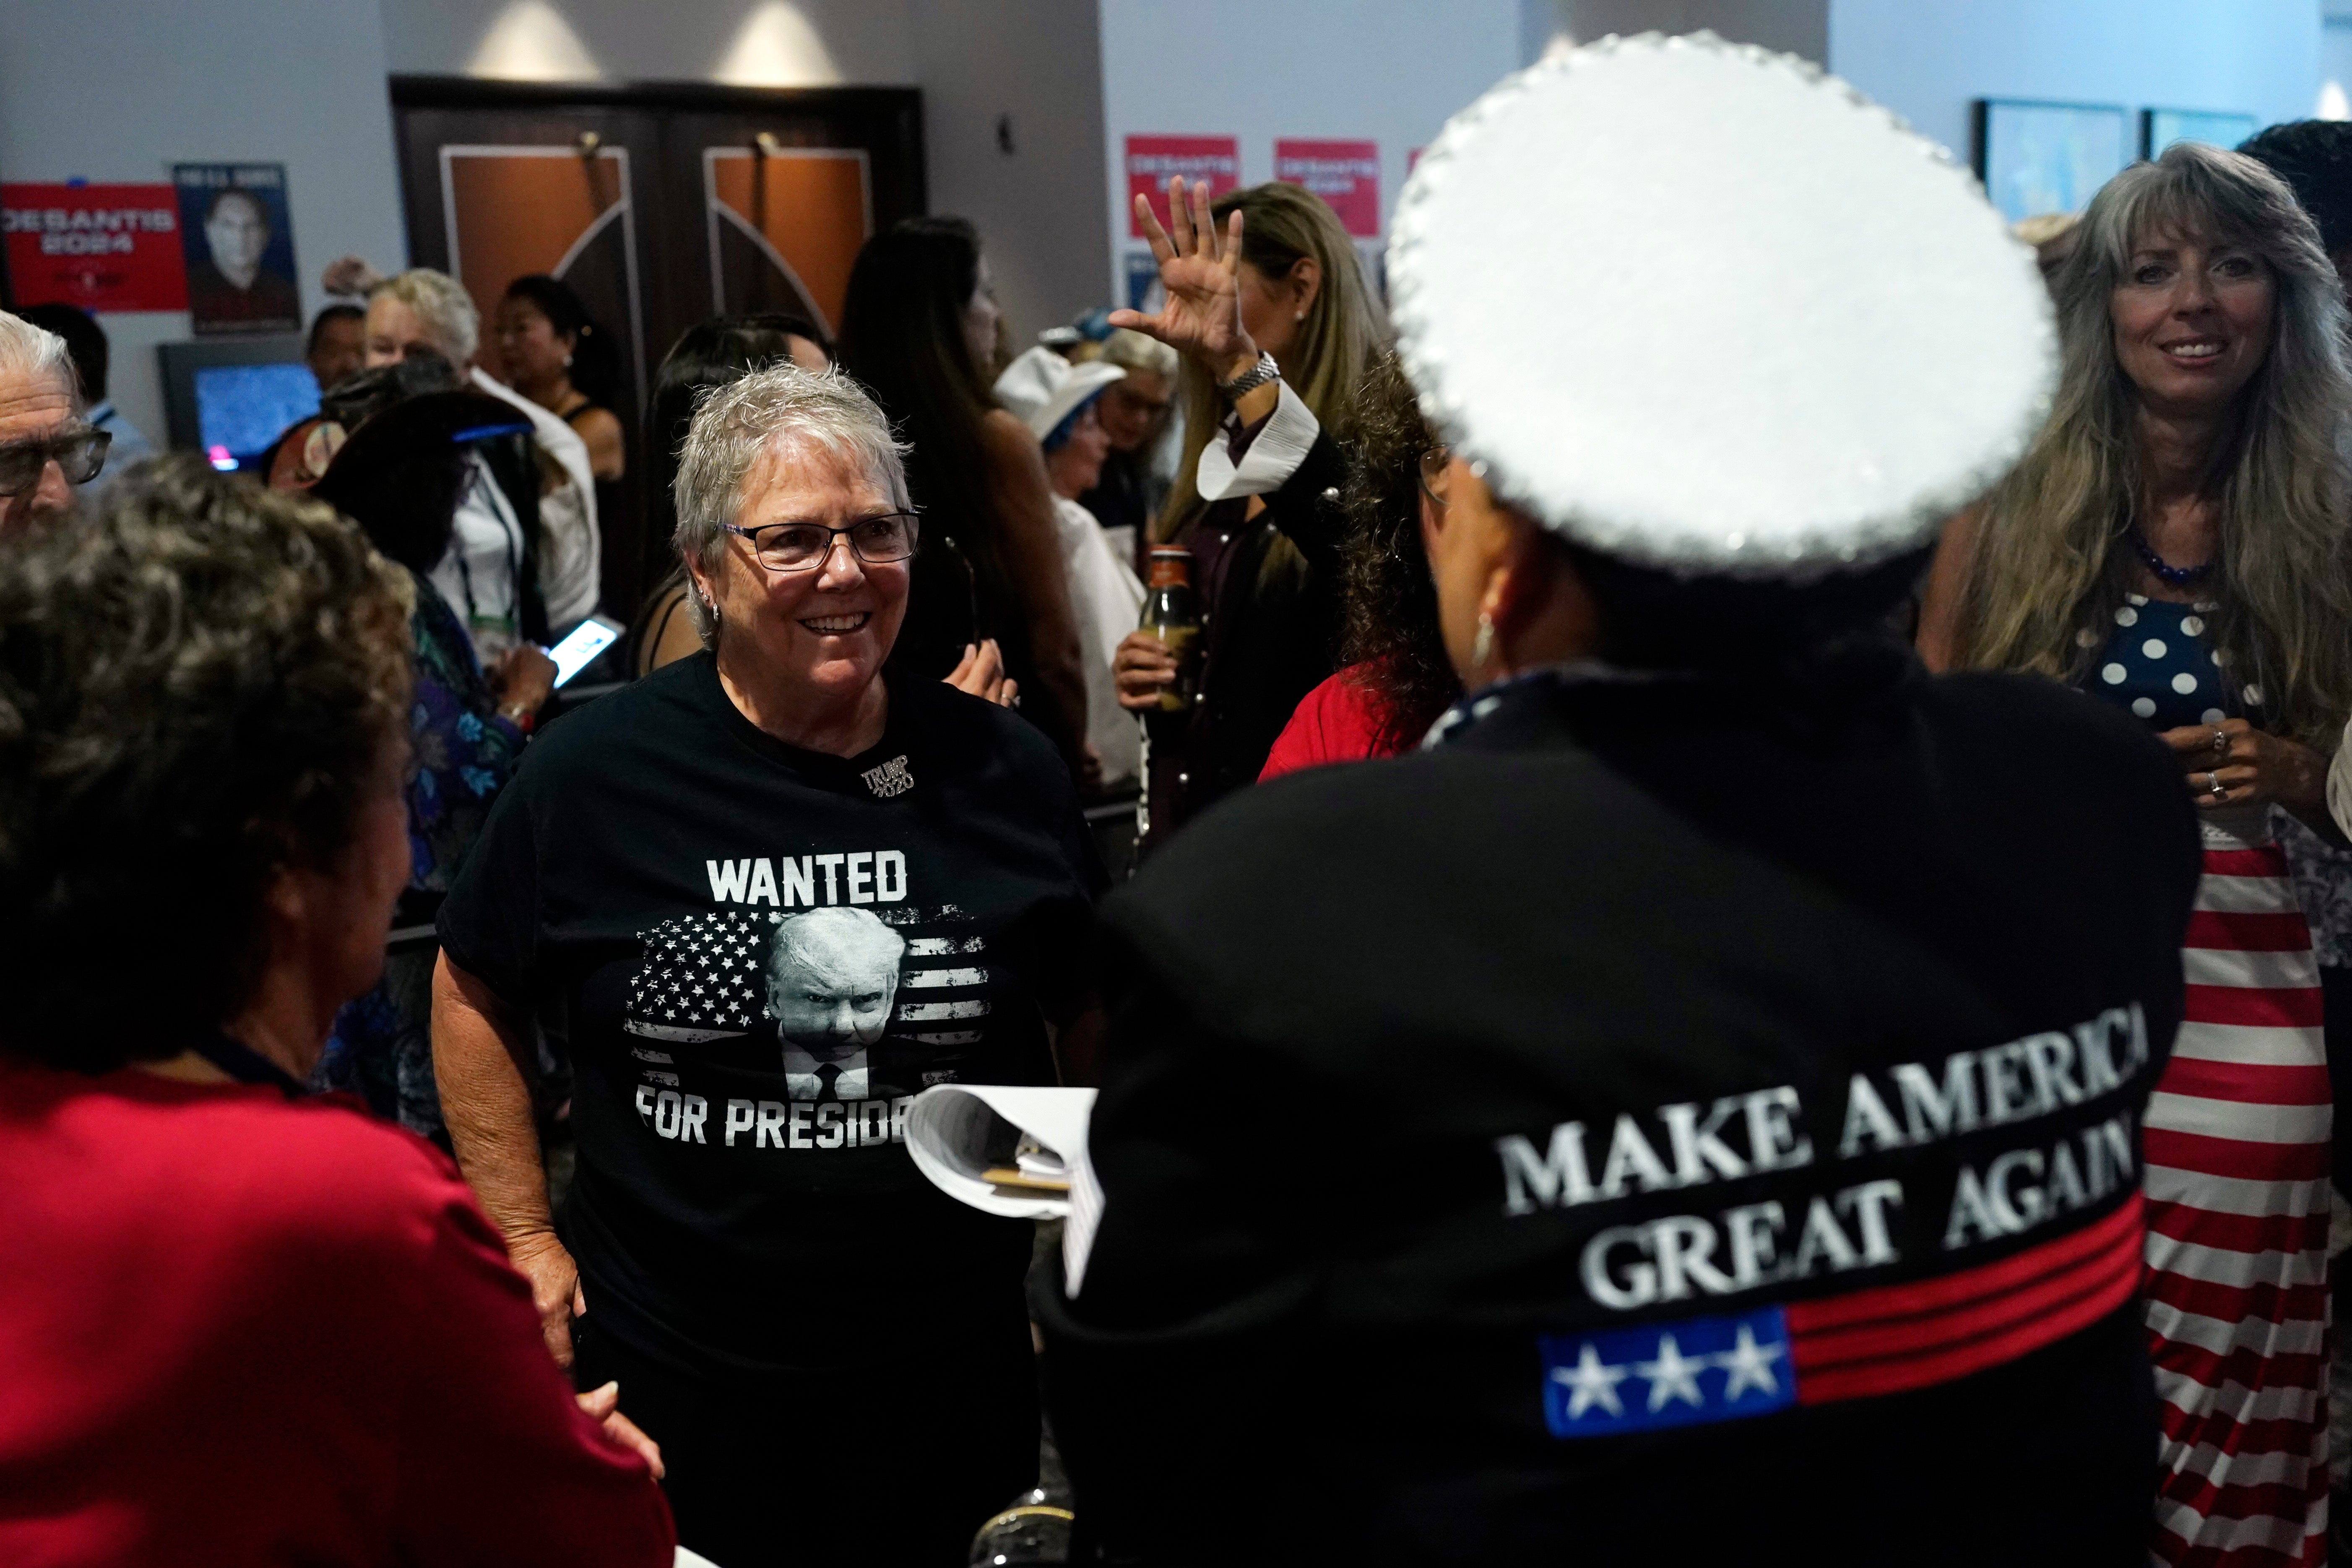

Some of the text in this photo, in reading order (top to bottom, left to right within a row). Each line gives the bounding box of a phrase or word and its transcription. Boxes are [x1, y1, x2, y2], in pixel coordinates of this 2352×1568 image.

[861, 755, 908, 789] TRUMP
[706, 850, 907, 906] WANTED
[636, 1085, 707, 1145] FOR
[1496, 1085, 1814, 1217] MAKE
[1580, 1111, 2133, 1311] GREAT AGAIN
